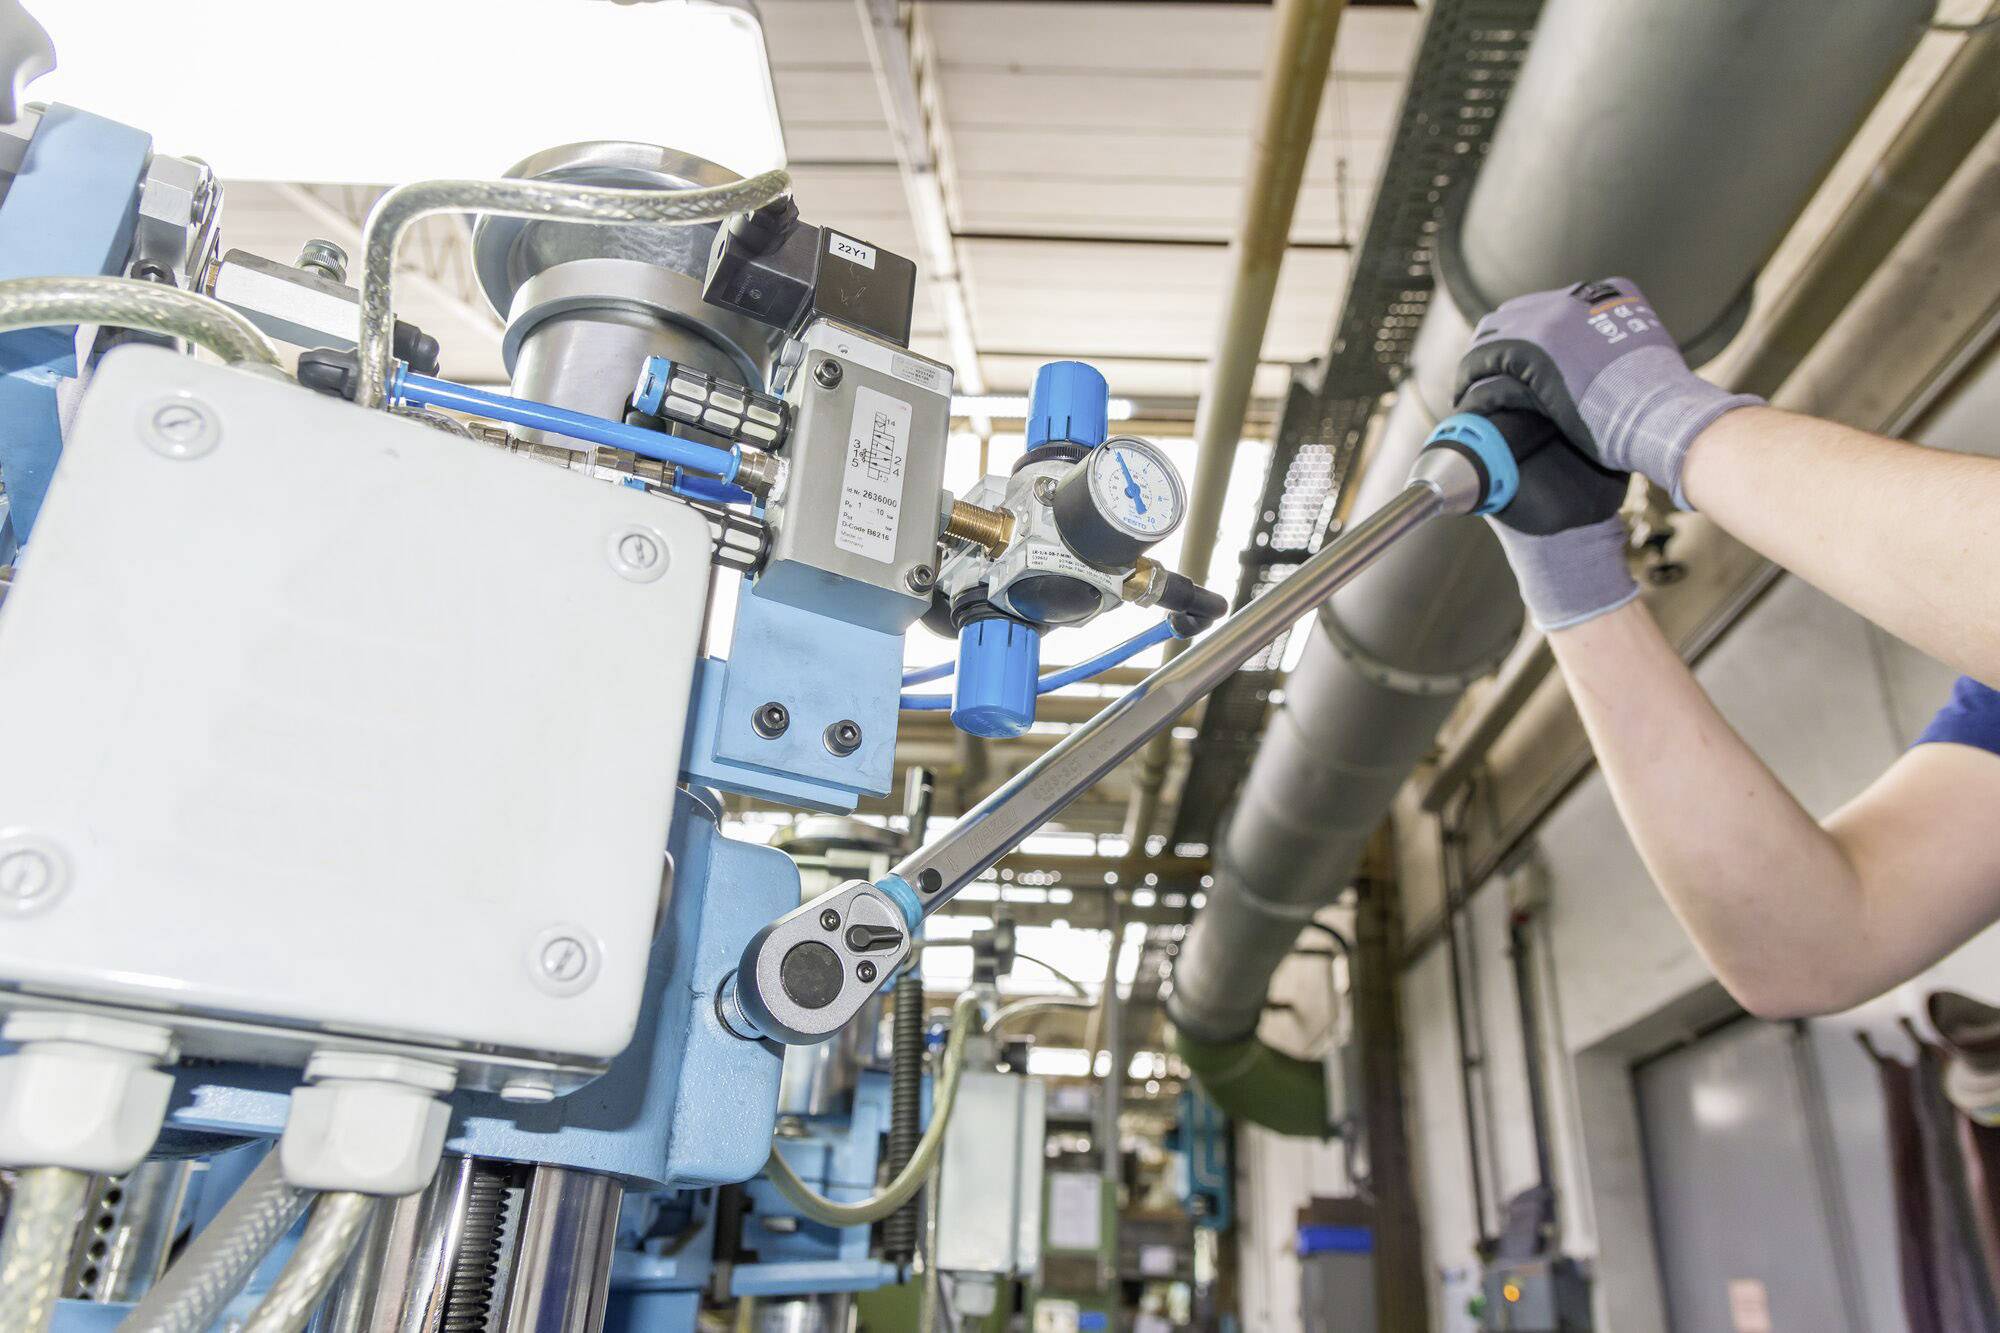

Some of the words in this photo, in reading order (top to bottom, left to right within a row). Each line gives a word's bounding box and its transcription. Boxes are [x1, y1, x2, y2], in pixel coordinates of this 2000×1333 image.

[838, 242, 866, 260] 22Y1
[853, 439, 861, 449] 3
[851, 458, 859, 468] 5
[894, 456, 902, 466] 2
[892, 468, 900, 476] 4
[863, 489, 897, 508] 2636000
[876, 508, 885, 516] 10
[1123, 516, 1147, 530] FESTO
[867, 528, 889, 541] B6216
